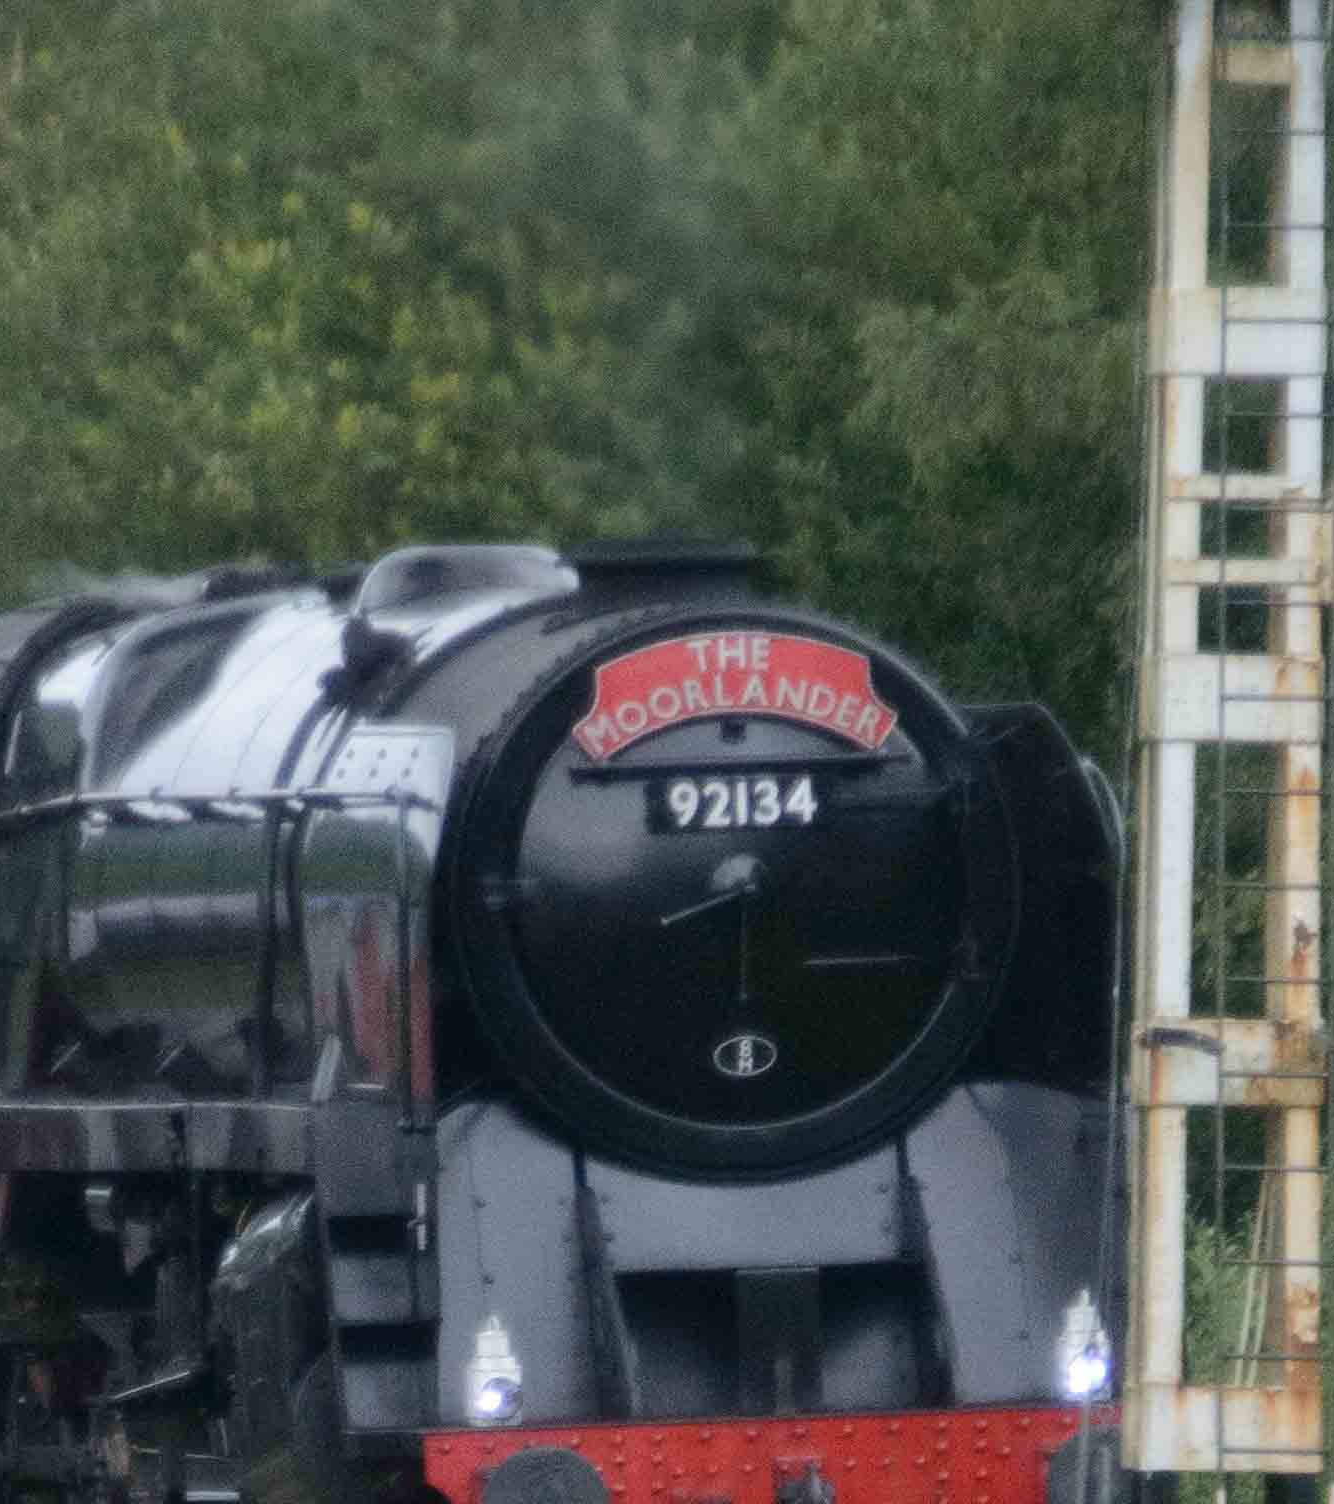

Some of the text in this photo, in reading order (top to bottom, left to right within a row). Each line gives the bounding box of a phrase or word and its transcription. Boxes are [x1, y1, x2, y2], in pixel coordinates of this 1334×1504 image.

[688, 639, 771, 672] THE
[583, 674, 880, 750] MOORLANDER
[669, 777, 818, 828] 92134
